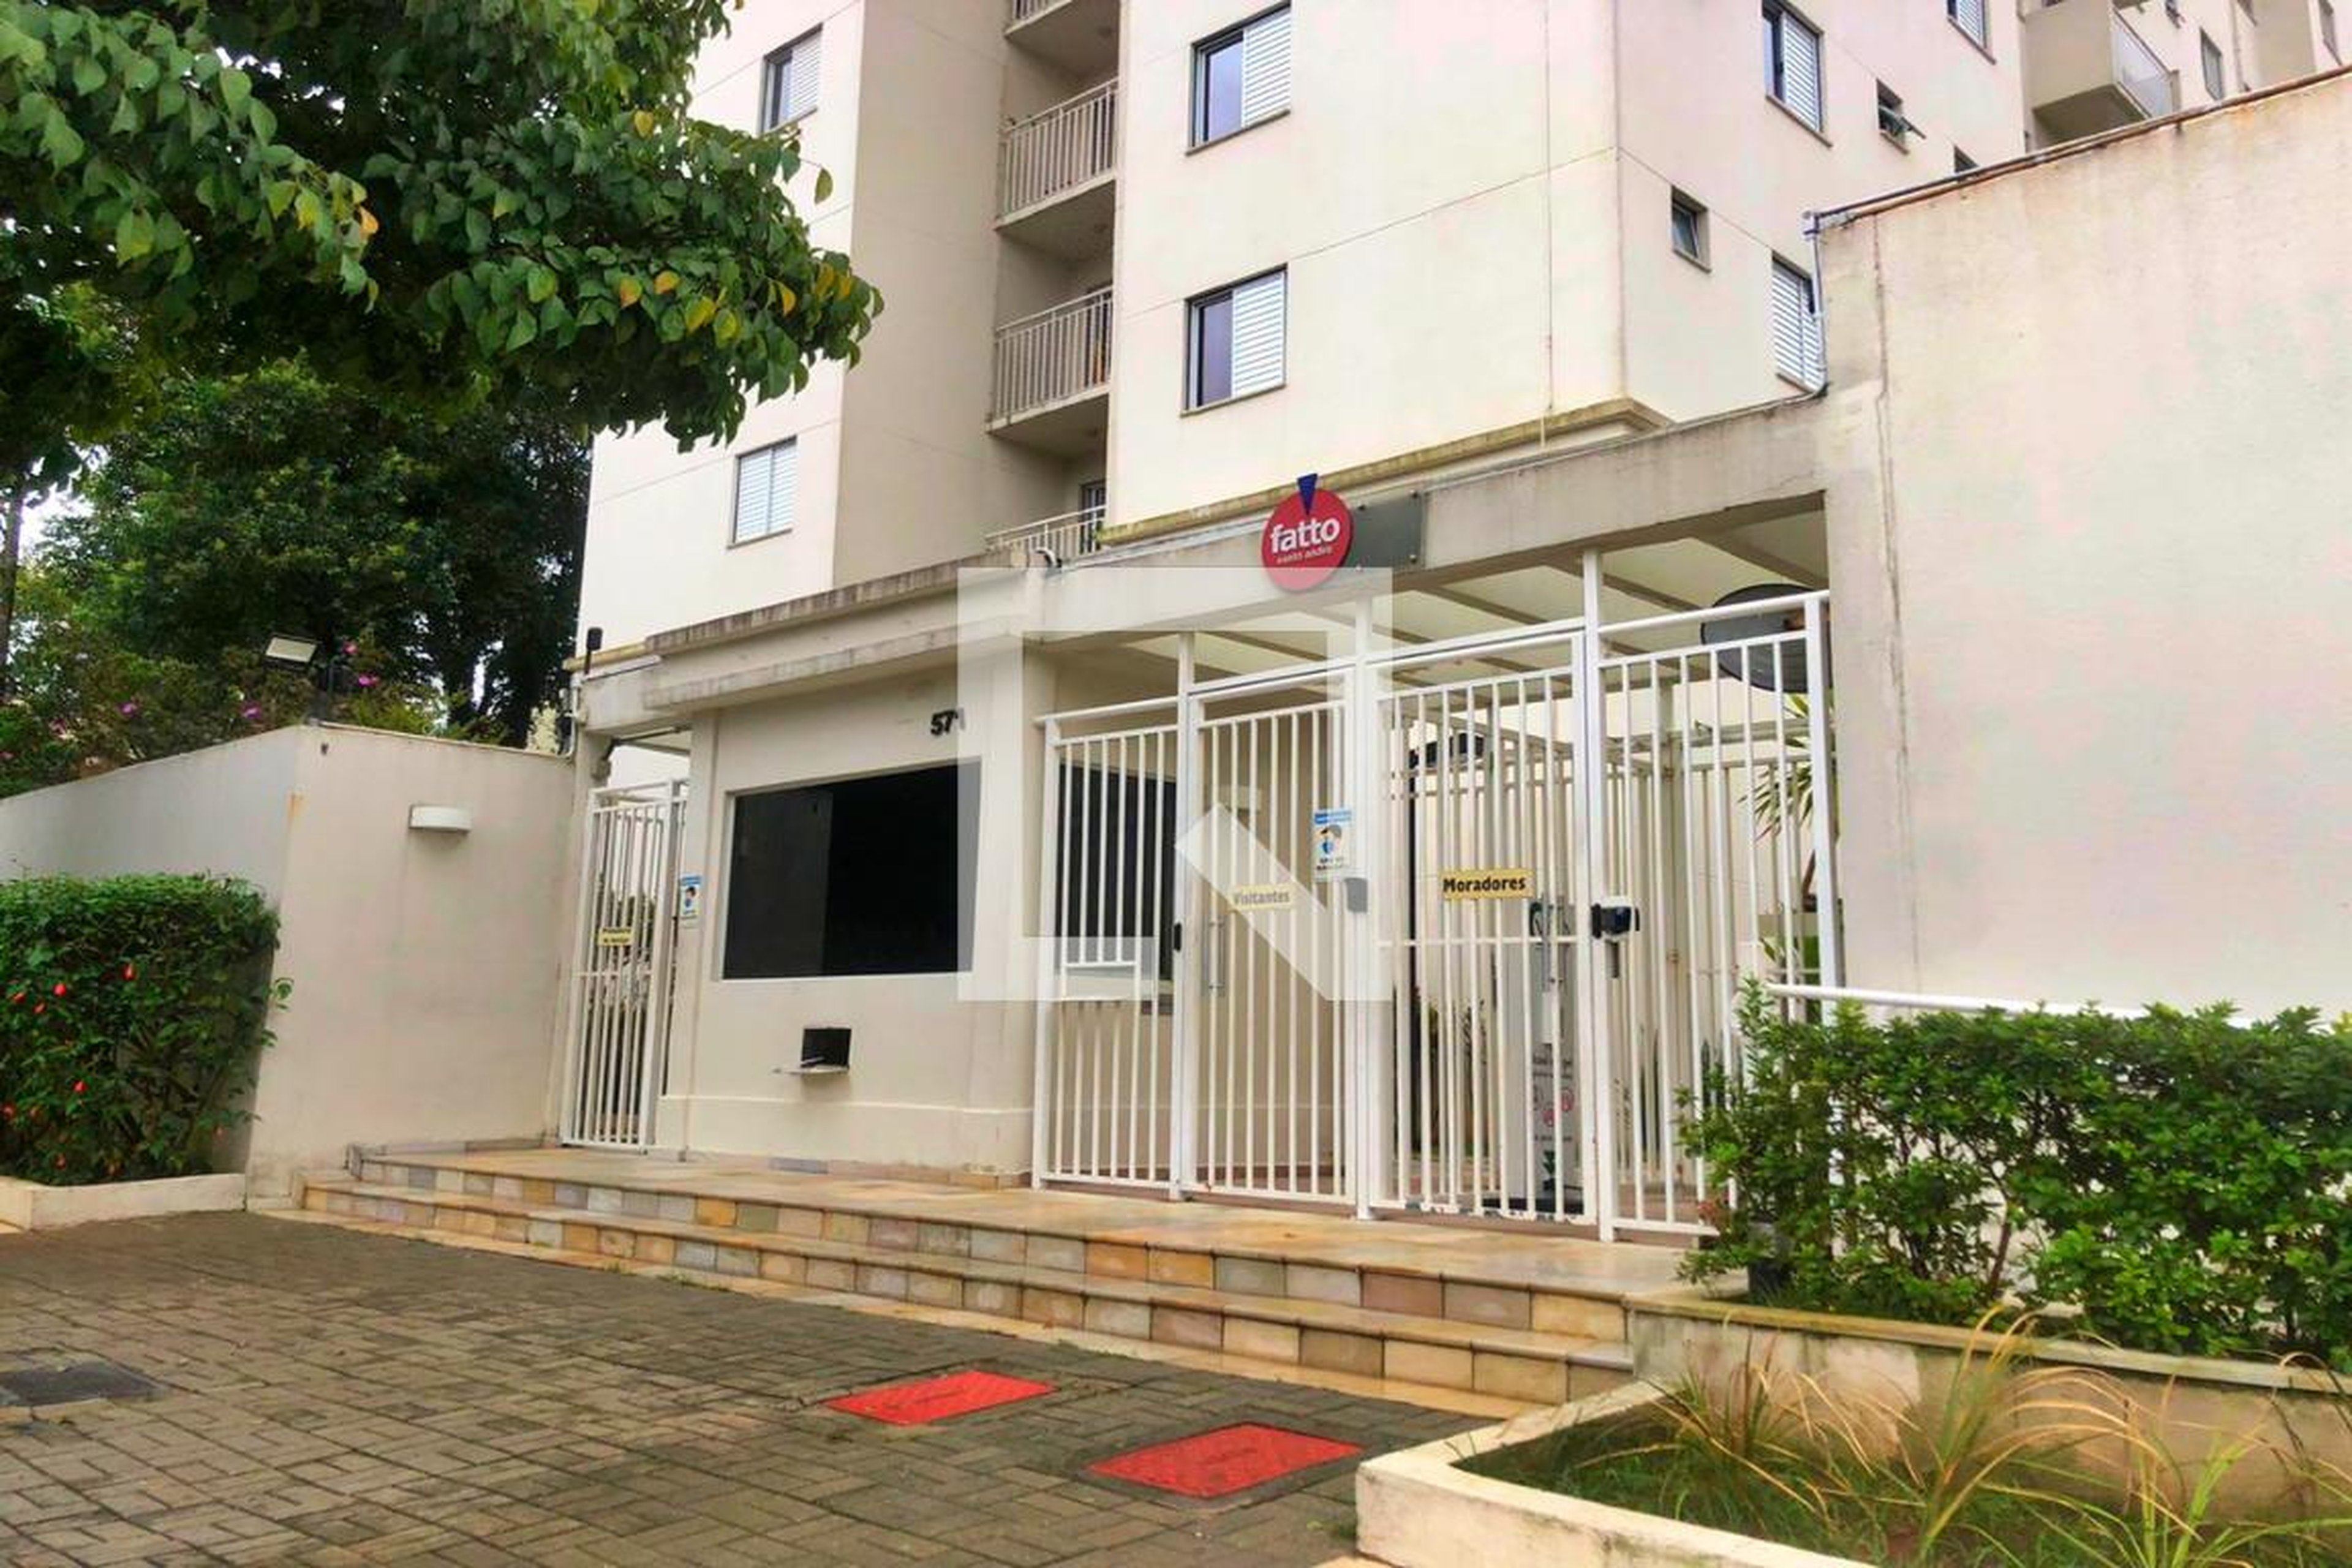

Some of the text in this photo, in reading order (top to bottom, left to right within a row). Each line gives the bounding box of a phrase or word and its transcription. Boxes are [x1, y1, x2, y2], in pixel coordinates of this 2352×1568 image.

[1270, 518, 1340, 554] fatto
[1442, 876, 1526, 892] Moradores
[1234, 891, 1290, 905] Visitantes
